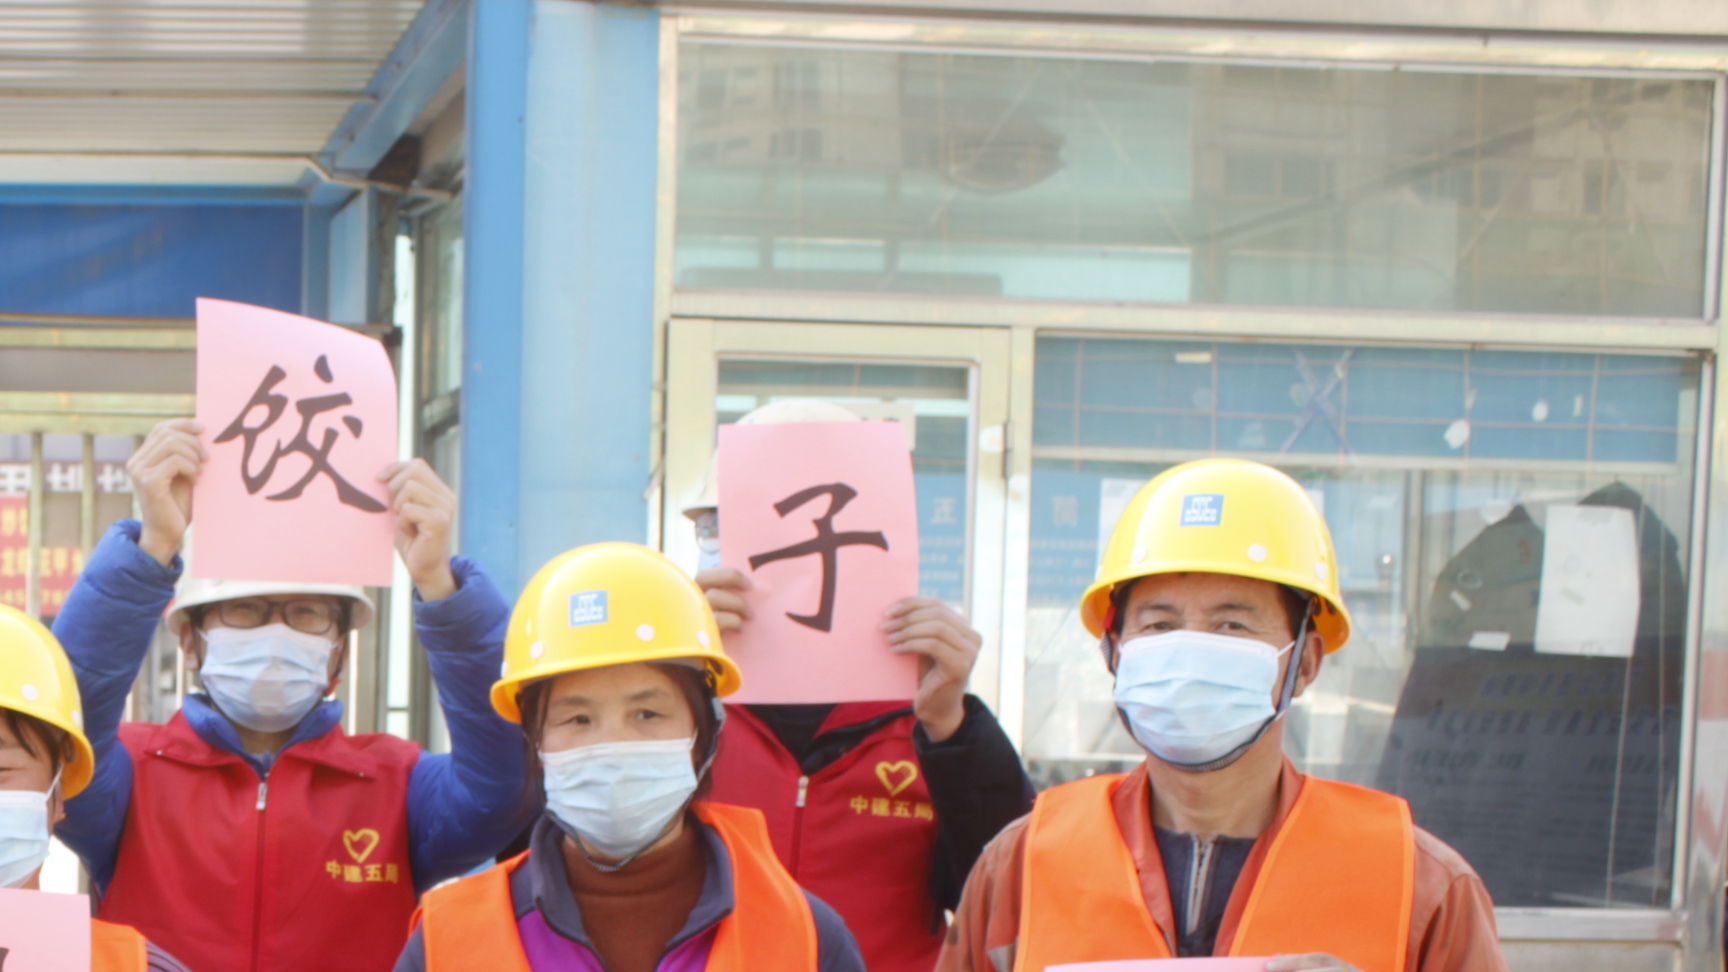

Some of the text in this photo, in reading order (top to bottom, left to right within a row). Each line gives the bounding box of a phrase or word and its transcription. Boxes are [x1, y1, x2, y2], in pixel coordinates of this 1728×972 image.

[213, 354, 389, 514] 饺
[747, 482, 890, 633] 子
[850, 795, 934, 821] 中建五局
[325, 859, 399, 884] 中建五局
